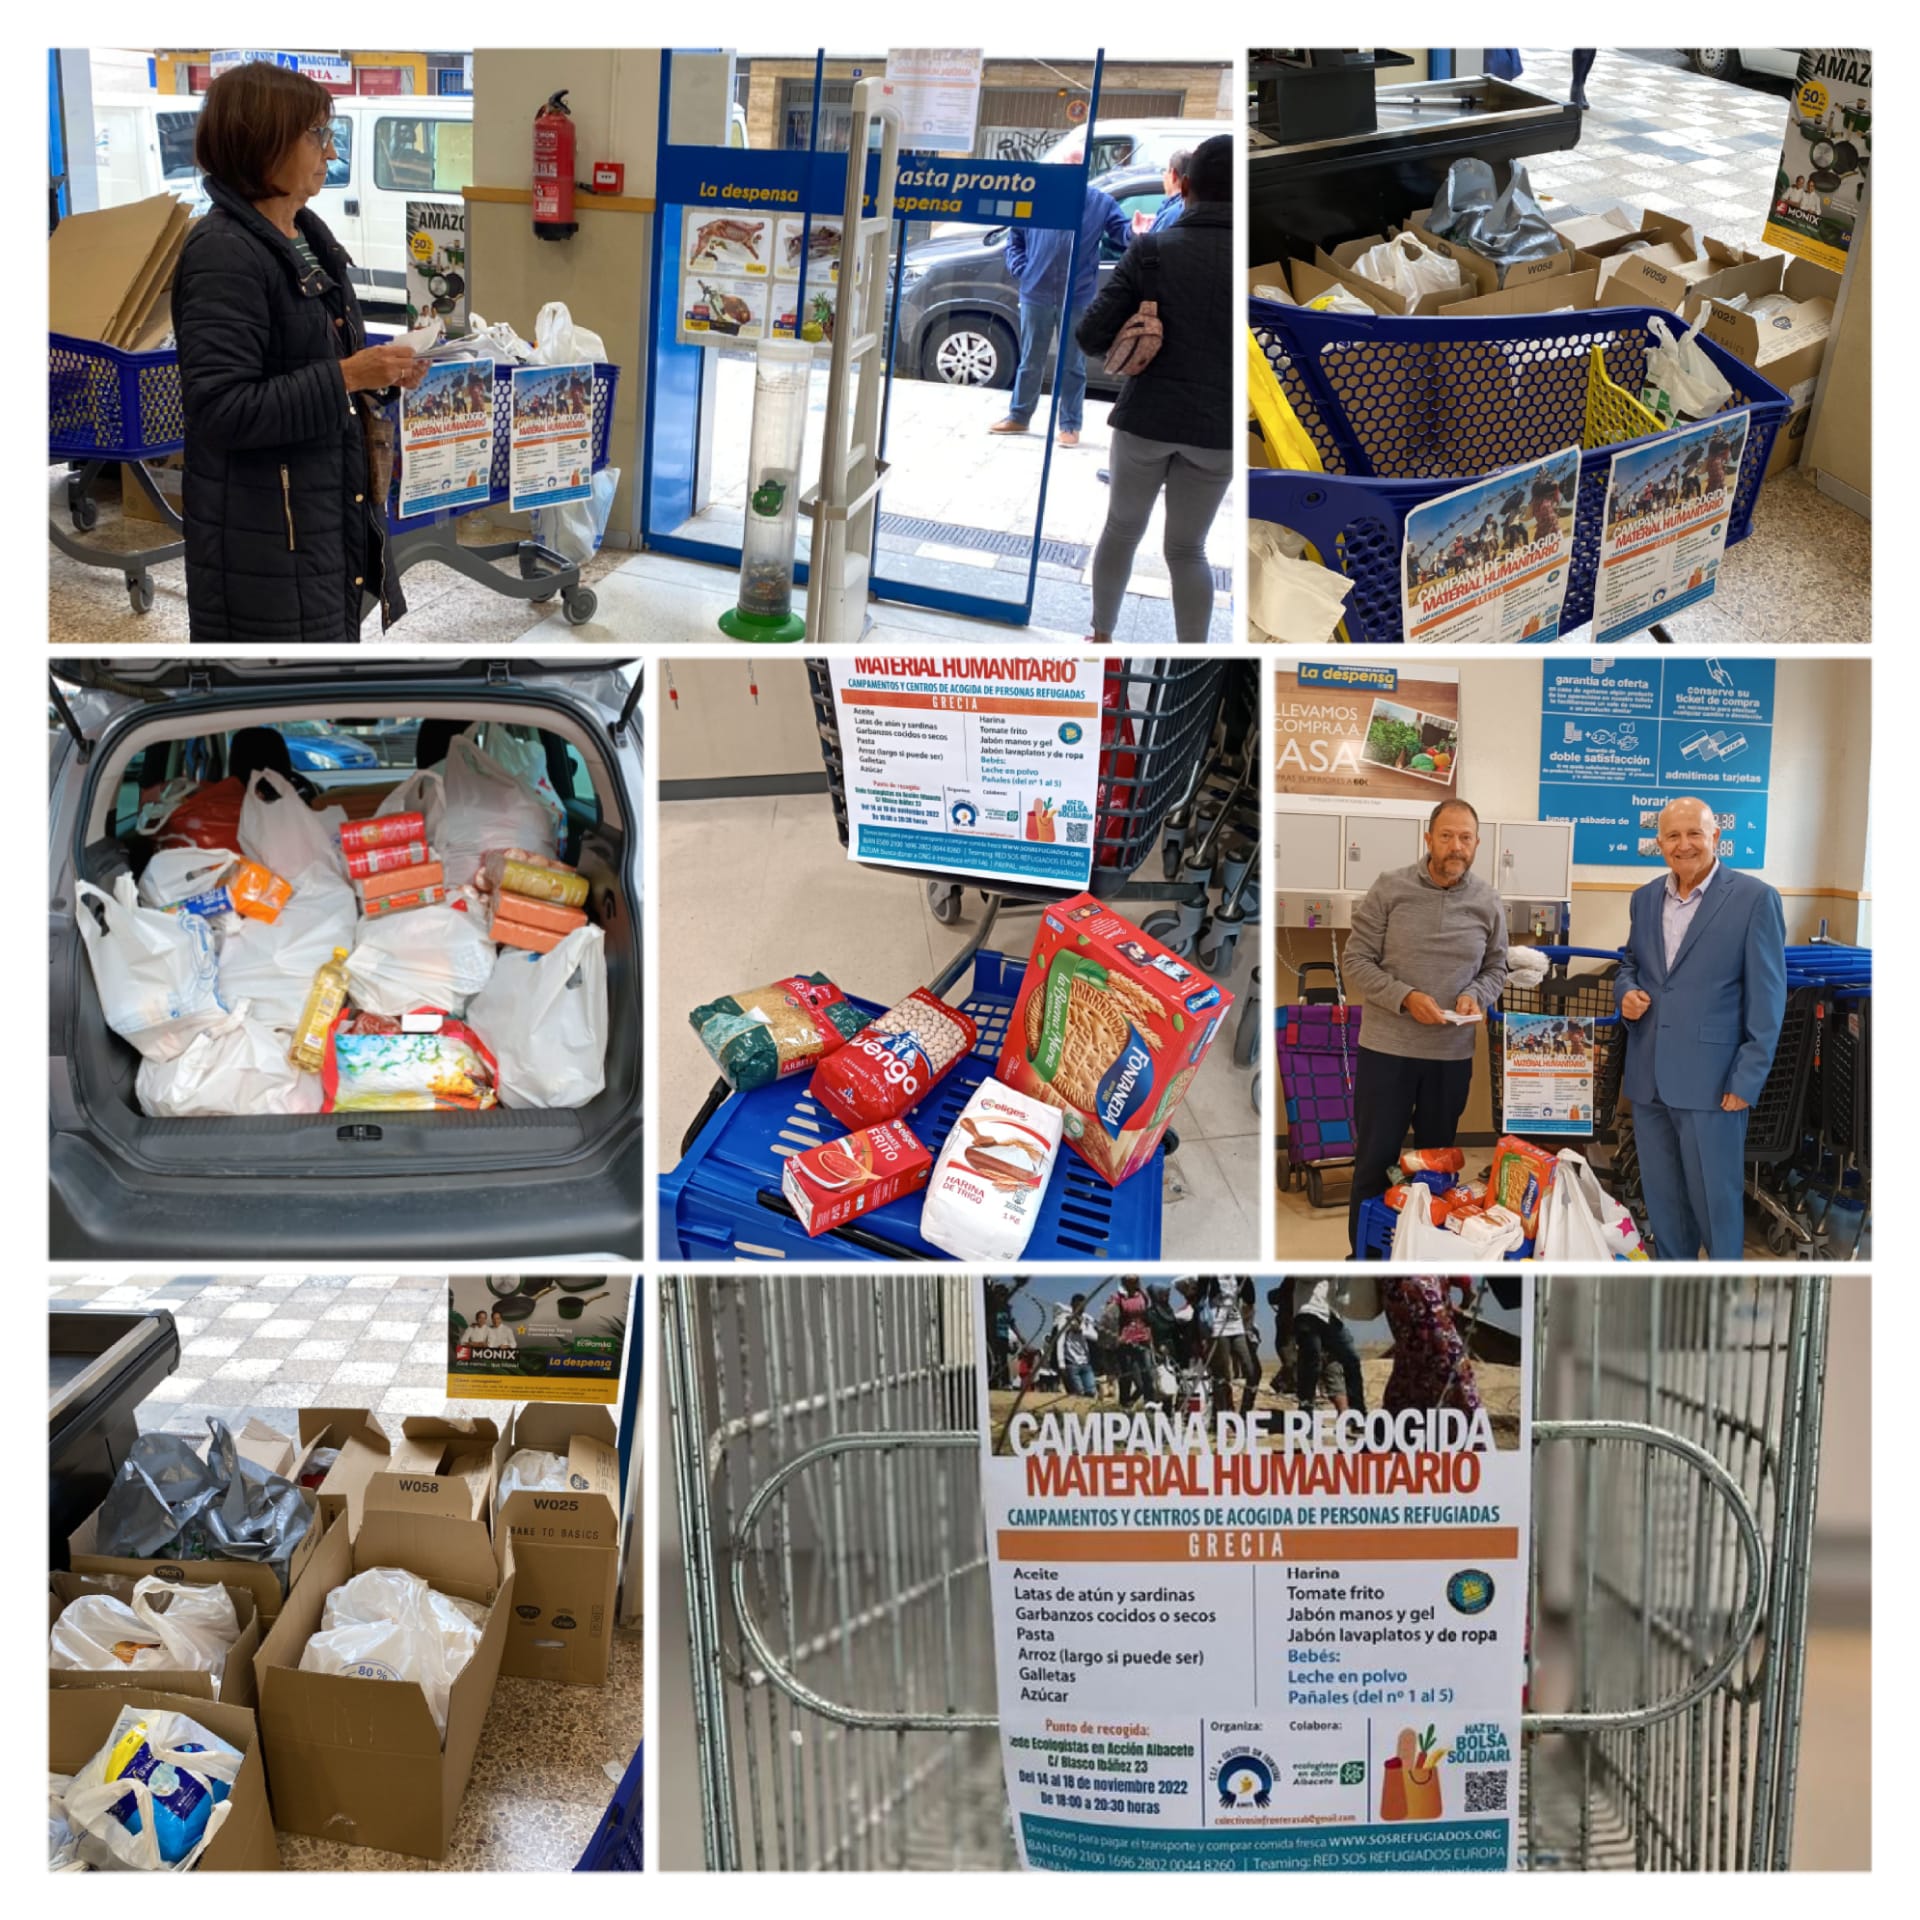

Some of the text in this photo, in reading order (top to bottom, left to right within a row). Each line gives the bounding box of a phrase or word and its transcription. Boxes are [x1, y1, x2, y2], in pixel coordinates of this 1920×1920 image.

[897, 165, 1036, 193] asta pronto
[700, 182, 799, 202] La despensa
[1423, 541, 1559, 613] MATERIAL HUMANITARIO
[855, 657, 1077, 683] MATERIAL HUMANITARIO
[1300, 665, 1318, 679] La
[1322, 667, 1395, 684] despensa
[848, 678, 1086, 699] CAMPAMENTOS CENTROS DE ACOGIDA DE PERSONAS REFUGIADAS
[1601, 677, 1615, 687] de
[1617, 678, 1649, 689] oferta
[1687, 686, 1750, 697] conserve su
[932, 695, 978, 710] GRECIA
[1676, 693, 1760, 708] ticket de compra
[856, 727, 920, 739] Garbanzos cocidos
[980, 726, 1028, 735] Tomate frito
[1348, 725, 1361, 737] A
[1549, 751, 1650, 765] doble satisfacción
[1665, 770, 1720, 781] admitimos
[1722, 772, 1762, 784] tarjetas
[1618, 816, 1629, 826] de
[1101, 1046, 1150, 1126] FONTANEDA
[994, 1103, 1027, 1119] eliges
[867, 1127, 898, 1161] FRITO
[880, 1125, 902, 1150] TOMATE
[943, 1182, 983, 1204] DE TRIGO
[946, 1175, 985, 1198] HARINA
[472, 1348, 516, 1360] MONIX
[549, 1357, 613, 1369] La despensa
[1216, 1411, 1272, 1456] DE
[1284, 1408, 1496, 1454] RECOGIDA
[1026, 1451, 1480, 1497] MATERIAL HUMANITARIO
[399, 1479, 439, 1493] W058
[533, 1498, 579, 1512] W025
[1008, 1506, 1500, 1526] CAMPAMENTOS Y CENTROS DE ACOGIDA DE PERSONAS REFUGIADAS
[1189, 1532, 1284, 1557] GRECIA
[1014, 1568, 1058, 1580] Aceite
[1287, 1568, 1340, 1580] Harina
[1015, 1587, 1195, 1604] Latas de atún y sardinas
[1287, 1586, 1384, 1600] Tomate frito
[1016, 1607, 1216, 1623] Garbanzos cocidos o secos
[1287, 1606, 1434, 1623] Jabón manos y gel
[1017, 1628, 1054, 1642] Pasta
[1287, 1628, 1497, 1644] Jabón lavaplatos y de ropa
[1018, 1647, 1204, 1667] Arroz (largo si puede ser)
[1288, 1649, 1341, 1662] Bebés:
[358, 1665, 374, 1677] 80
[1019, 1667, 1076, 1683] Galletas
[1288, 1669, 1407, 1686] Leche en polvo
[1020, 1687, 1069, 1702] Azúcar
[1288, 1688, 1453, 1705] Pañales (del al 5)
[1046, 1719, 1150, 1739] Punto de recogida:
[1211, 1722, 1263, 1733] Organiza:
[1290, 1721, 1342, 1731] Colabora:
[1465, 1724, 1485, 1734] HAZ
[1032, 1737, 1194, 1757] Ecologistas en Acción Albacete
[1456, 1733, 1507, 1750] BOLSA
[1061, 1757, 1148, 1773] Blasco Ibáñez 23
[1019, 1770, 1188, 1794] Del 14 al 18 de noviembre 2022
[1041, 1791, 1053, 1805] De
[1094, 1797, 1125, 1812] 20:30
[1128, 1799, 1160, 1815] horas
[1330, 1828, 1501, 1847] WWW.SOSREFUGIADOS.ORG
[1080, 1850, 1105, 1864] 2100
[1108, 1854, 1135, 1867] 1696
[1138, 1857, 1167, 1871] 2802
[1170, 1859, 1200, 1871] 0044
[1204, 1859, 1235, 1871] 8260
[1254, 1856, 1311, 1871] Teaming:
[1313, 1855, 1338, 1866] RED
[1342, 1853, 1366, 1865] SOS
[1370, 1849, 1450, 1864] REFUGIADOS
[1454, 1846, 1505, 1860] EUROPA
